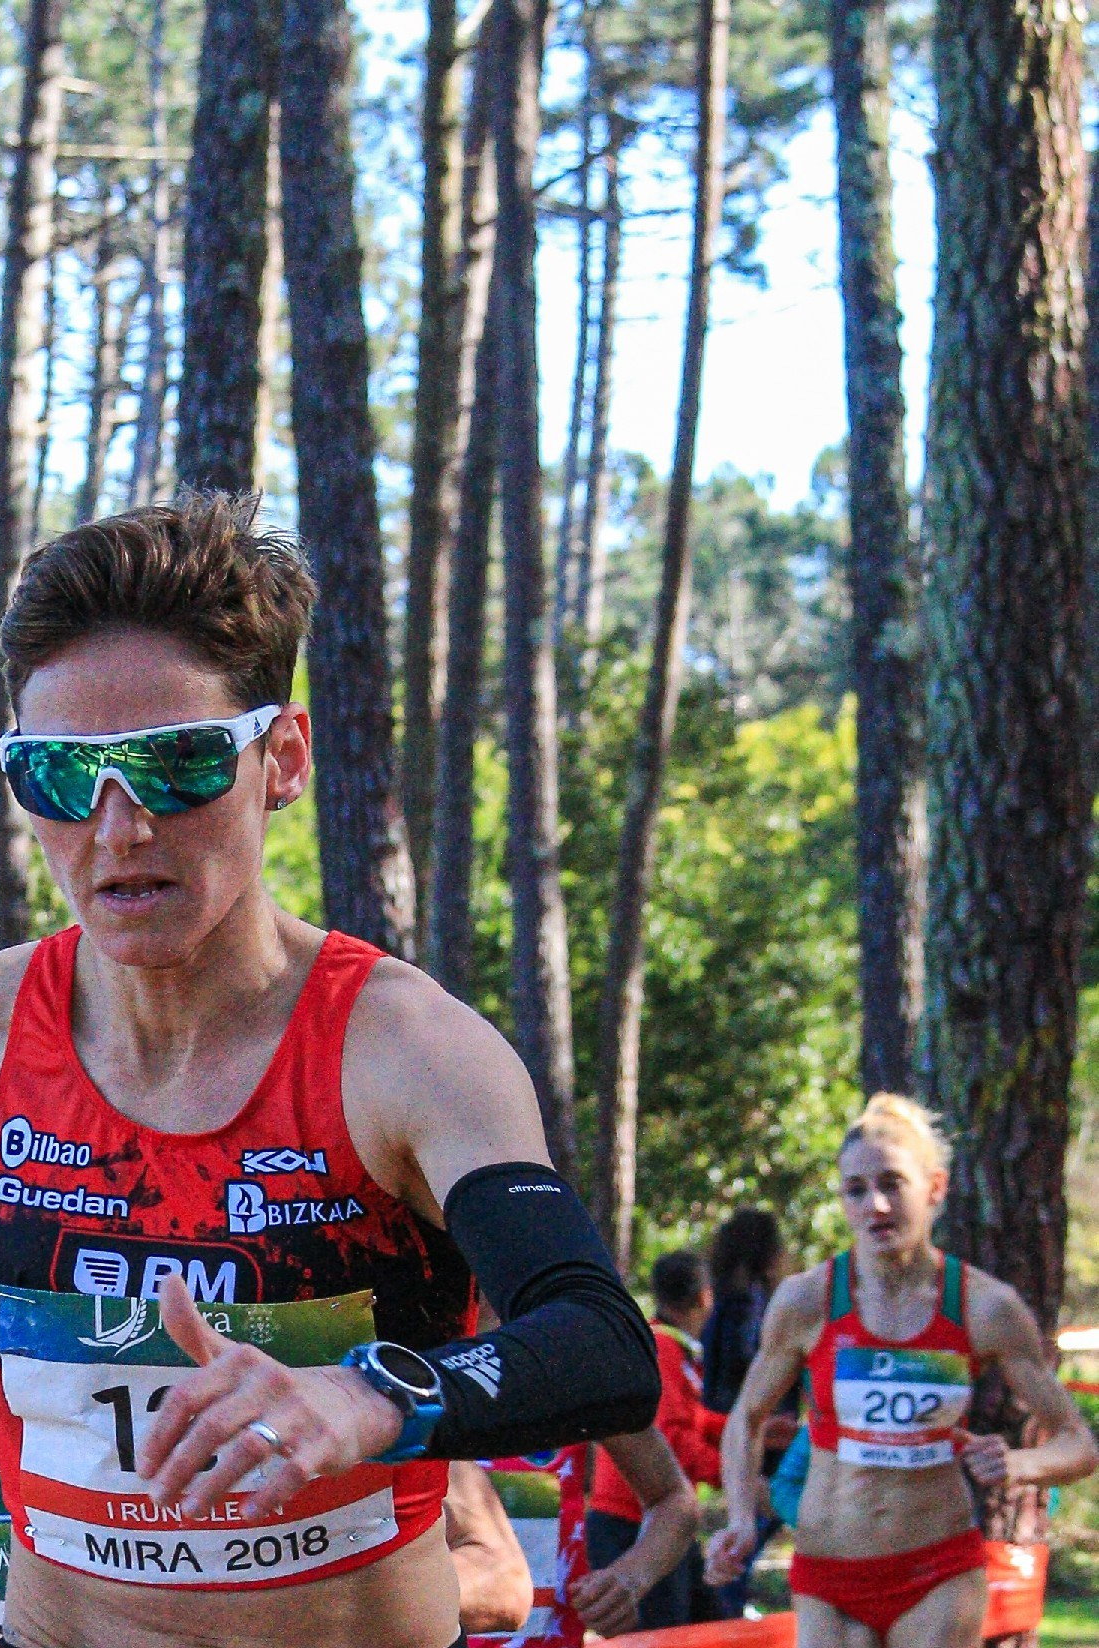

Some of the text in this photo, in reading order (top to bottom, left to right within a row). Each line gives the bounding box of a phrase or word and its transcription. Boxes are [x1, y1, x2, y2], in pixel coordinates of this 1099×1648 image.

[2, 1117, 90, 1167] Bilbao
[865, 1390, 942, 1424] 202
[106, 1501, 114, 1520] I
[120, 1502, 182, 1522] RUN
[84, 1525, 330, 1573] MIRA 2018
